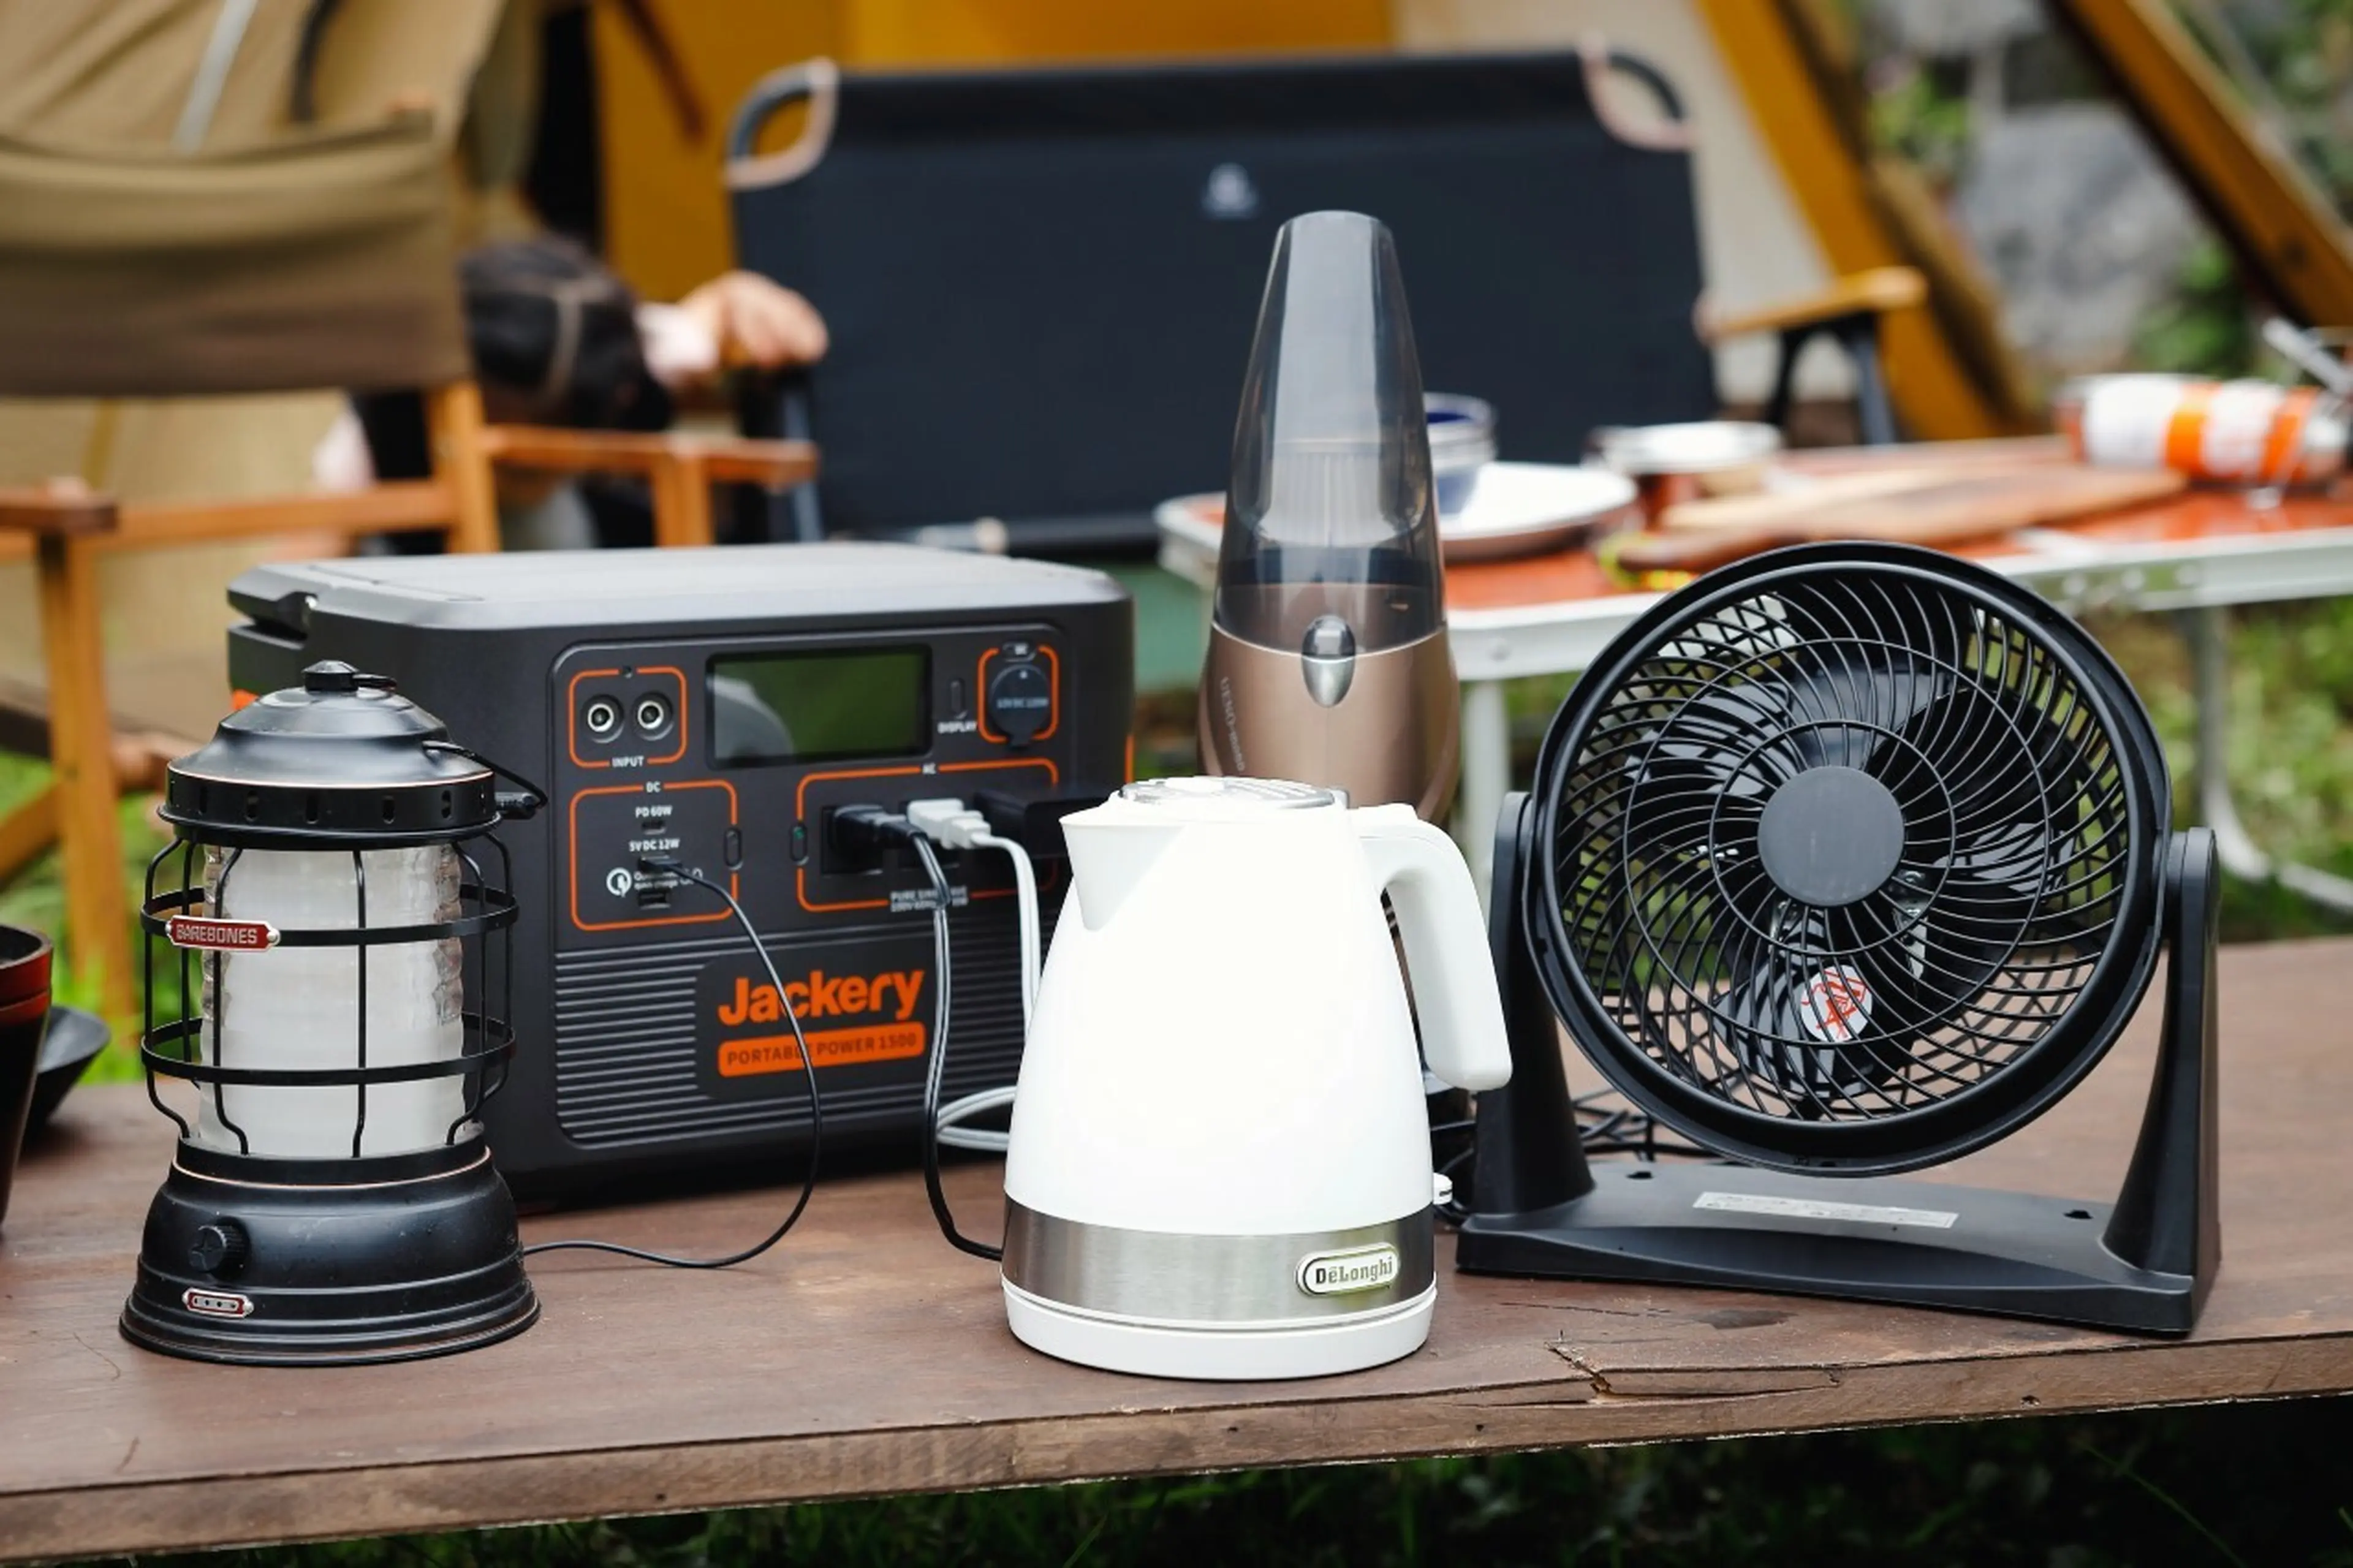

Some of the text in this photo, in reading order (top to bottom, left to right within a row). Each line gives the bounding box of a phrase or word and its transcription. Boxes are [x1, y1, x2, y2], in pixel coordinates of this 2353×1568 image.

[938, 721, 977, 733] DISPLAY
[612, 756, 644, 767] INPUT
[646, 781, 661, 793] DC
[635, 805, 673, 818] PD 60W
[629, 840, 642, 852] 5V
[176, 924, 257, 944] BAREBONES
[718, 969, 925, 1026] Jackery
[817, 1037, 874, 1055] POWER
[879, 1032, 916, 1050] 1500
